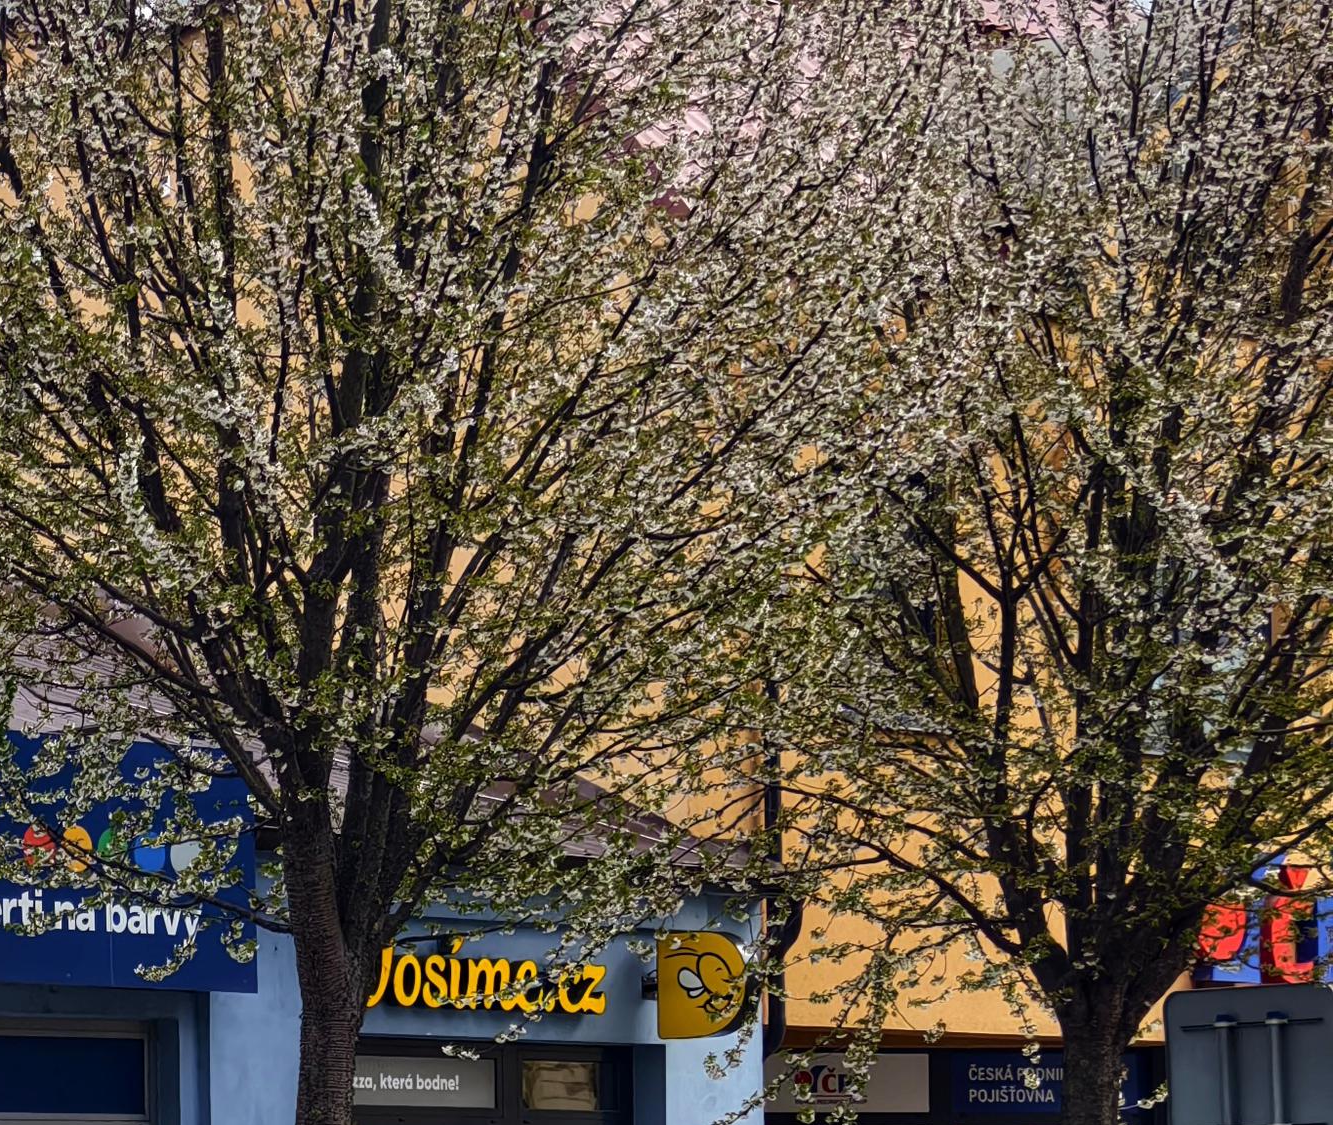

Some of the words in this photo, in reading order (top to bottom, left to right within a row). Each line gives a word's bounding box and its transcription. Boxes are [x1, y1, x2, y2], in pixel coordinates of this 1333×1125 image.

[55, 899, 96, 932] na
[968, 1064, 1013, 1081] ČESKÁ
[380, 1073, 413, 1089] která
[416, 1074, 459, 1091] bodne!
[969, 1086, 1055, 1102] POJIŠŤOVNA
